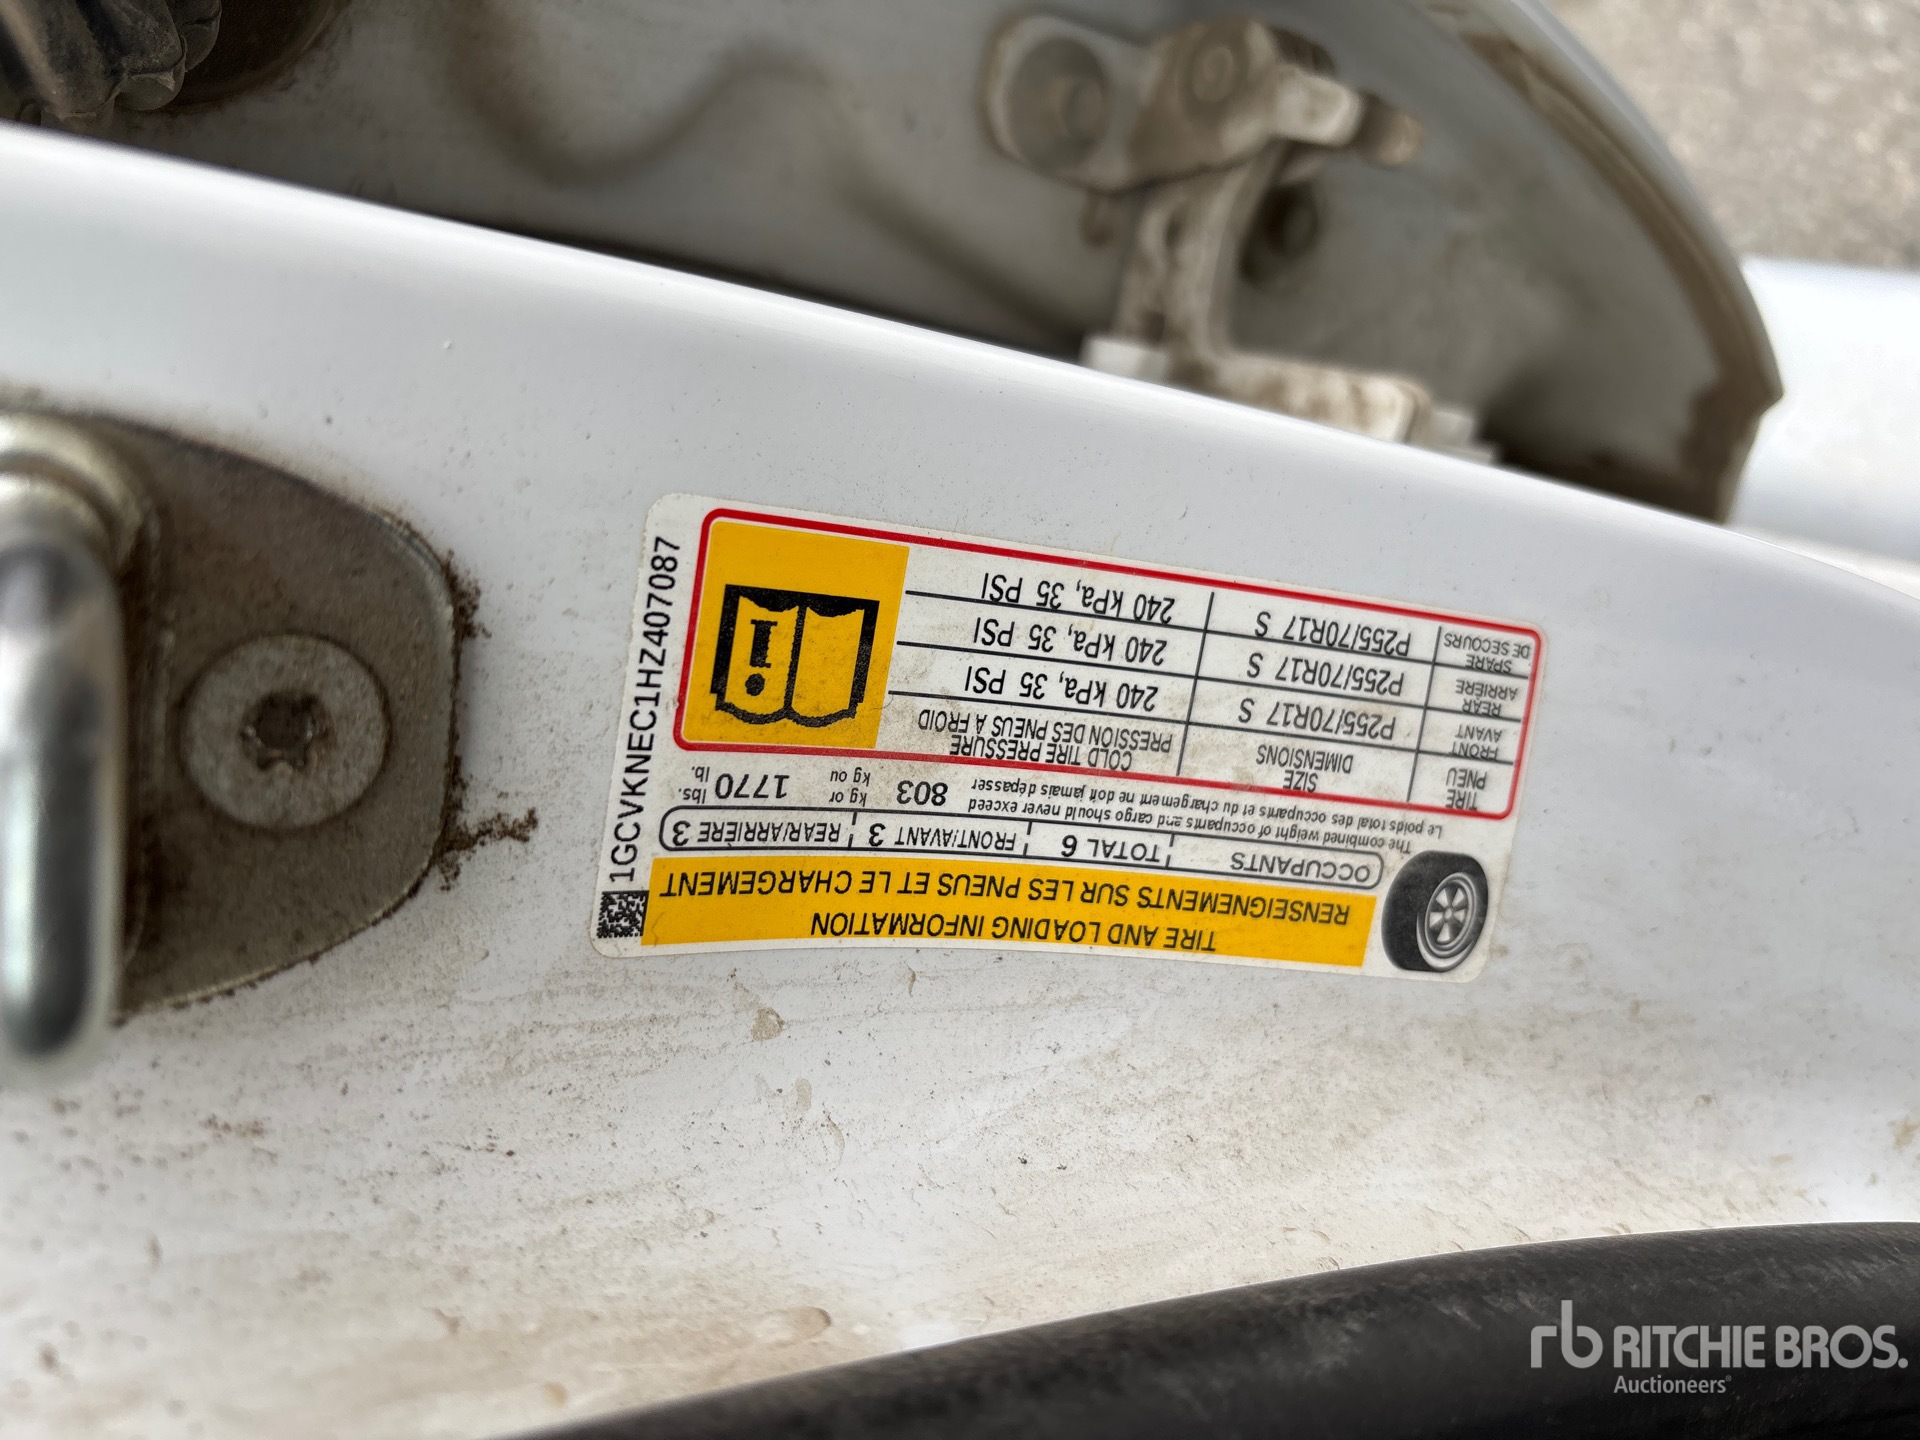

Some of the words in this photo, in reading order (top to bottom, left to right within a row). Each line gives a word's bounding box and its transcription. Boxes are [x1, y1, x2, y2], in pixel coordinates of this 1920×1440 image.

[981, 573, 1023, 603] PSI
[1036, 580, 1065, 609] 35
[1075, 580, 1124, 618] kPa,
[1133, 594, 1176, 624] 240
[973, 617, 1015, 647] PSI
[1254, 611, 1272, 638] S
[1282, 615, 1411, 657] P255/70R17
[1028, 624, 1057, 651] 35
[1067, 624, 1116, 661] kPa,
[1443, 632, 1510, 656] SECOURS
[1125, 636, 1168, 666] 240
[1510, 643, 1531, 659] DE
[1247, 652, 1264, 678] S
[1465, 653, 1513, 674] SPARE
[964, 666, 1006, 694] PSI
[1019, 672, 1048, 699] 35
[1274, 657, 1405, 697] P255/70R17
[1059, 671, 1107, 708] kPa,
[1116, 683, 1158, 712] 240
[1455, 679, 1518, 701] ARRIÈRE
[610, 536, 681, 882] 1GCVKNEC1HZ407087
[1237, 698, 1255, 724] S
[1462, 698, 1502, 717] REAR
[918, 709, 969, 733] FROID
[991, 715, 1048, 740] PNEUS
[1052, 721, 1085, 743] DES
[1265, 701, 1397, 741] P255/70R17
[1088, 725, 1172, 754] PRESSION
[1454, 724, 1503, 743] AVANT
[950, 734, 1041, 762] PRESSURE
[1045, 743, 1081, 765] TIRE
[1088, 747, 1132, 772] COLD
[1255, 744, 1354, 774] DIMENSIONS
[1452, 742, 1499, 762] FRONT
[691, 767, 710, 784] lb.
[715, 773, 790, 800] 1770
[830, 770, 848, 784] ou
[853, 767, 872, 785] kg
[971, 778, 1037, 796] dépasser
[1283, 770, 1317, 793] SIZE
[1446, 768, 1487, 790] PNEU
[677, 787, 707, 803] lbs.
[829, 791, 845, 804] or
[849, 787, 868, 807] kg
[897, 780, 949, 807] 803
[1041, 784, 1086, 799] jamais
[1089, 788, 1115, 802] doit
[1119, 792, 1135, 803] ne
[1140, 793, 1218, 811] chargement
[1446, 789, 1478, 812] TIRE
[968, 798, 1018, 813] exceed
[1022, 803, 1060, 816] never
[1065, 806, 1110, 821] should
[1115, 810, 1153, 824] cargo
[1222, 802, 1239, 814] du
[1242, 804, 1255, 816] et
[1259, 806, 1327, 823] occupants
[1186, 817, 1255, 833] occupants
[1258, 823, 1271, 838] of
[1331, 814, 1353, 828] des
[1357, 815, 1387, 830] total
[1389, 820, 1424, 835] poids
[1428, 824, 1442, 840] Le
[672, 820, 691, 846] 3
[868, 823, 886, 846] 3
[894, 828, 1018, 851] FRONT/AVANT
[1276, 826, 1319, 842] weight
[1323, 833, 1384, 848] combined
[1061, 835, 1077, 858] 6
[1087, 837, 1161, 862] TOTAL
[1389, 840, 1411, 854] The
[1230, 852, 1370, 883] OCCUPANTS
[659, 870, 852, 897] CHARGEMENT
[860, 871, 891, 894] LE
[897, 872, 929, 895] ET
[936, 873, 1020, 899] PNEUS
[1028, 876, 1072, 903] LES
[1080, 881, 1128, 907] SUR
[1136, 886, 1350, 926] RENSEIGNEMENTS
[810, 911, 984, 938] INFORMATION
[991, 914, 1099, 944] LOADING
[1108, 920, 1156, 947] AND
[1164, 924, 1216, 952] TIRE
